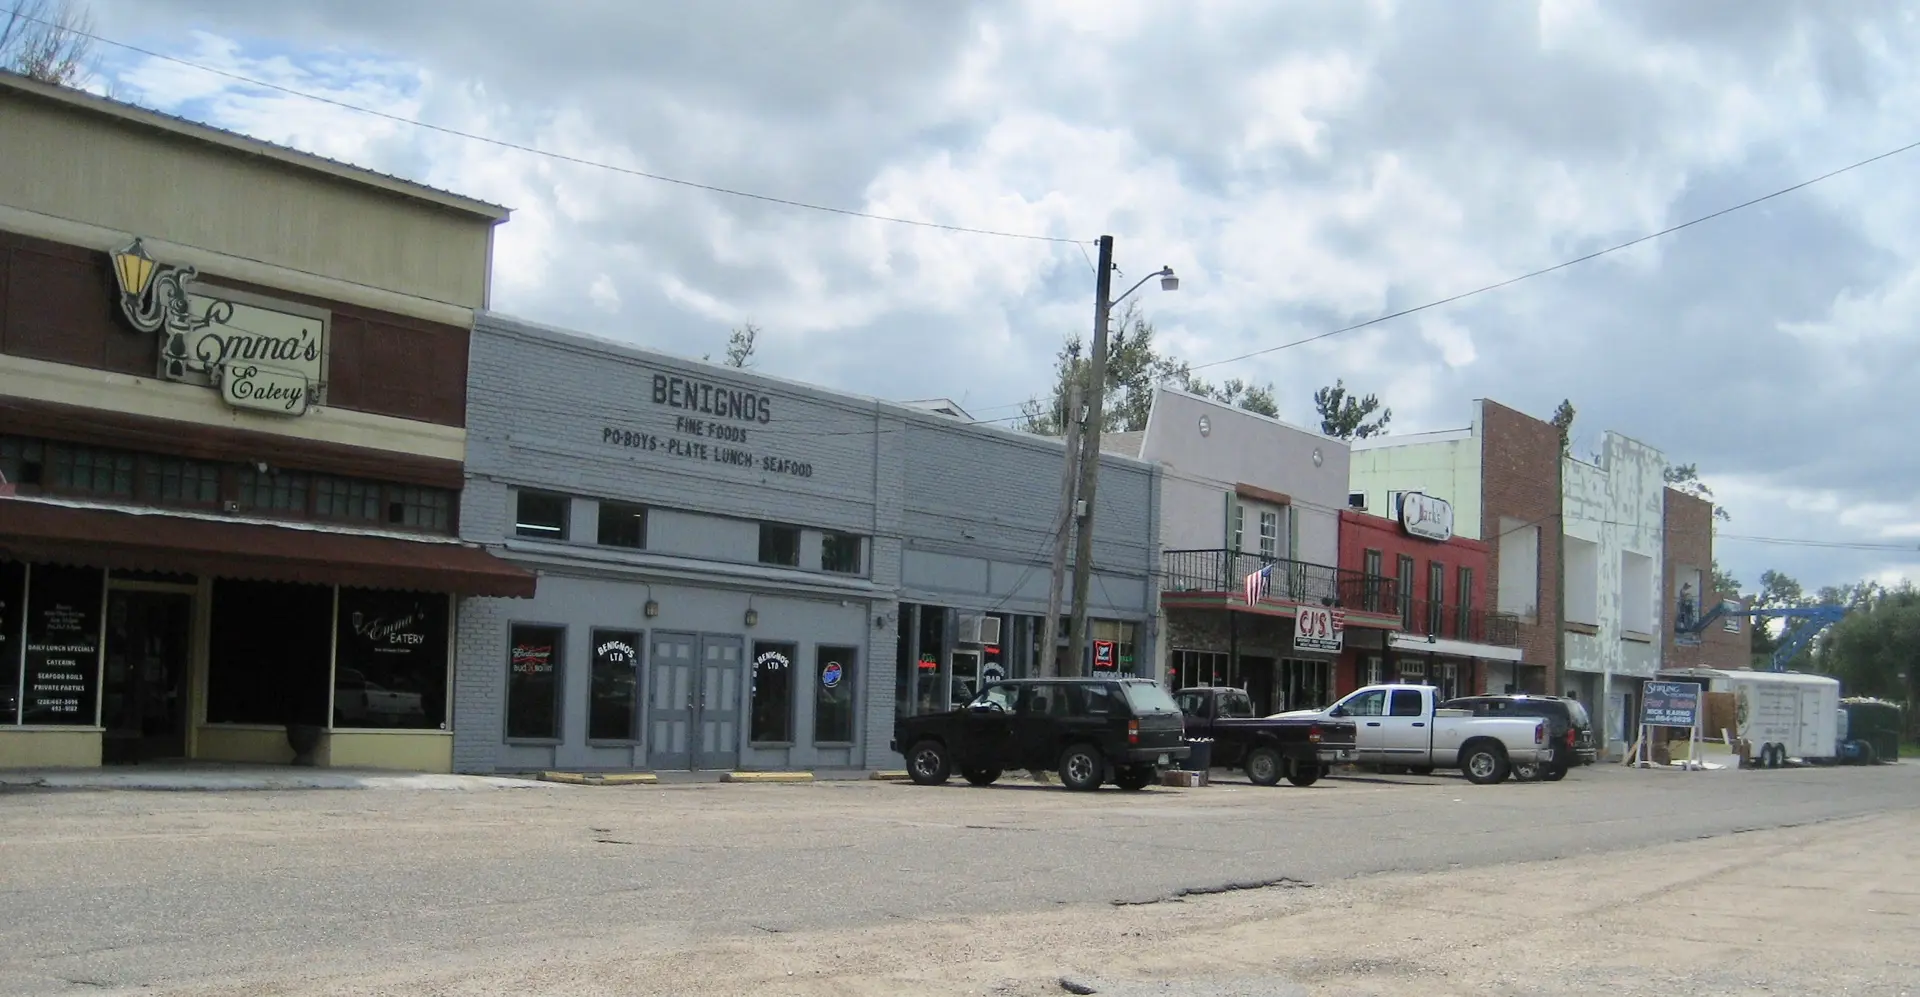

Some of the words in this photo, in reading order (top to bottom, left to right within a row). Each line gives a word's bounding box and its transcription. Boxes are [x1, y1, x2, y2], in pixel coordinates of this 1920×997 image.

[193, 300, 320, 366] Emma's
[231, 366, 303, 409] Eatery
[652, 374, 771, 424] BENIGNOS
[676, 416, 703, 436] FINE
[708, 423, 747, 443] FOODS
[603, 427, 657, 451] PO-BOYS
[668, 439, 707, 460] PLATE
[714, 446, 752, 468] LUNCH
[762, 456, 813, 477] SEAFOOD
[390, 632, 424, 644] EATERY
[27, 644, 45, 652] DAILY
[67, 645, 95, 653] SPECIALS
[609, 652, 624, 661] LTD
[46, 659, 76, 667] CATERING
[767, 662, 779, 670] LTD
[37, 672, 65, 680] SEAFOOD
[66, 673, 83, 681] BOILS
[34, 684, 59, 692] PRIVATE
[60, 684, 85, 692] PARTIES
